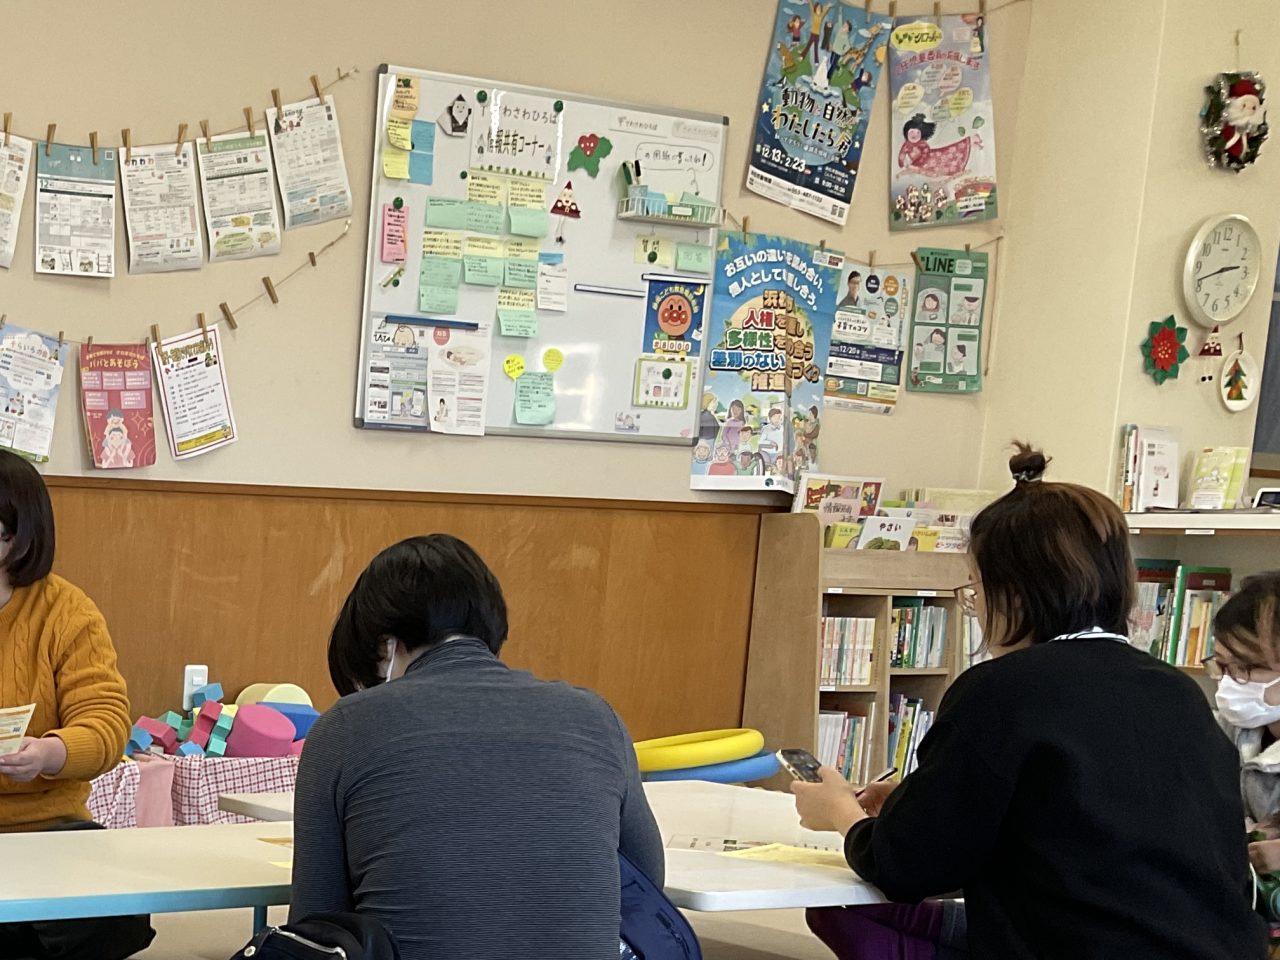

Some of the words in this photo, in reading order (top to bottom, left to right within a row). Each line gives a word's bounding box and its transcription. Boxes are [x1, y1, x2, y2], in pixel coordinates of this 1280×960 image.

[1213, 232, 1221, 245] 11
[1223, 228, 1233, 241] 12
[1236, 235, 1240, 247] 1
[1202, 243, 1212, 257] 10
[1240, 248, 1247, 260] 2
[925, 256, 955, 273] LINE
[1196, 261, 1202, 274] 9
[1241, 267, 1248, 280] 3
[1233, 286, 1240, 298] 4
[1203, 294, 1210, 307] 7
[1212, 299, 1218, 312] 6
[1224, 296, 1230, 309] 5
[837, 321, 868, 333] 子育てのコツ
[654, 341, 690, 351] #8000
[89, 358, 139, 370] パパとあそぼう
[880, 522, 902, 532] やさい
